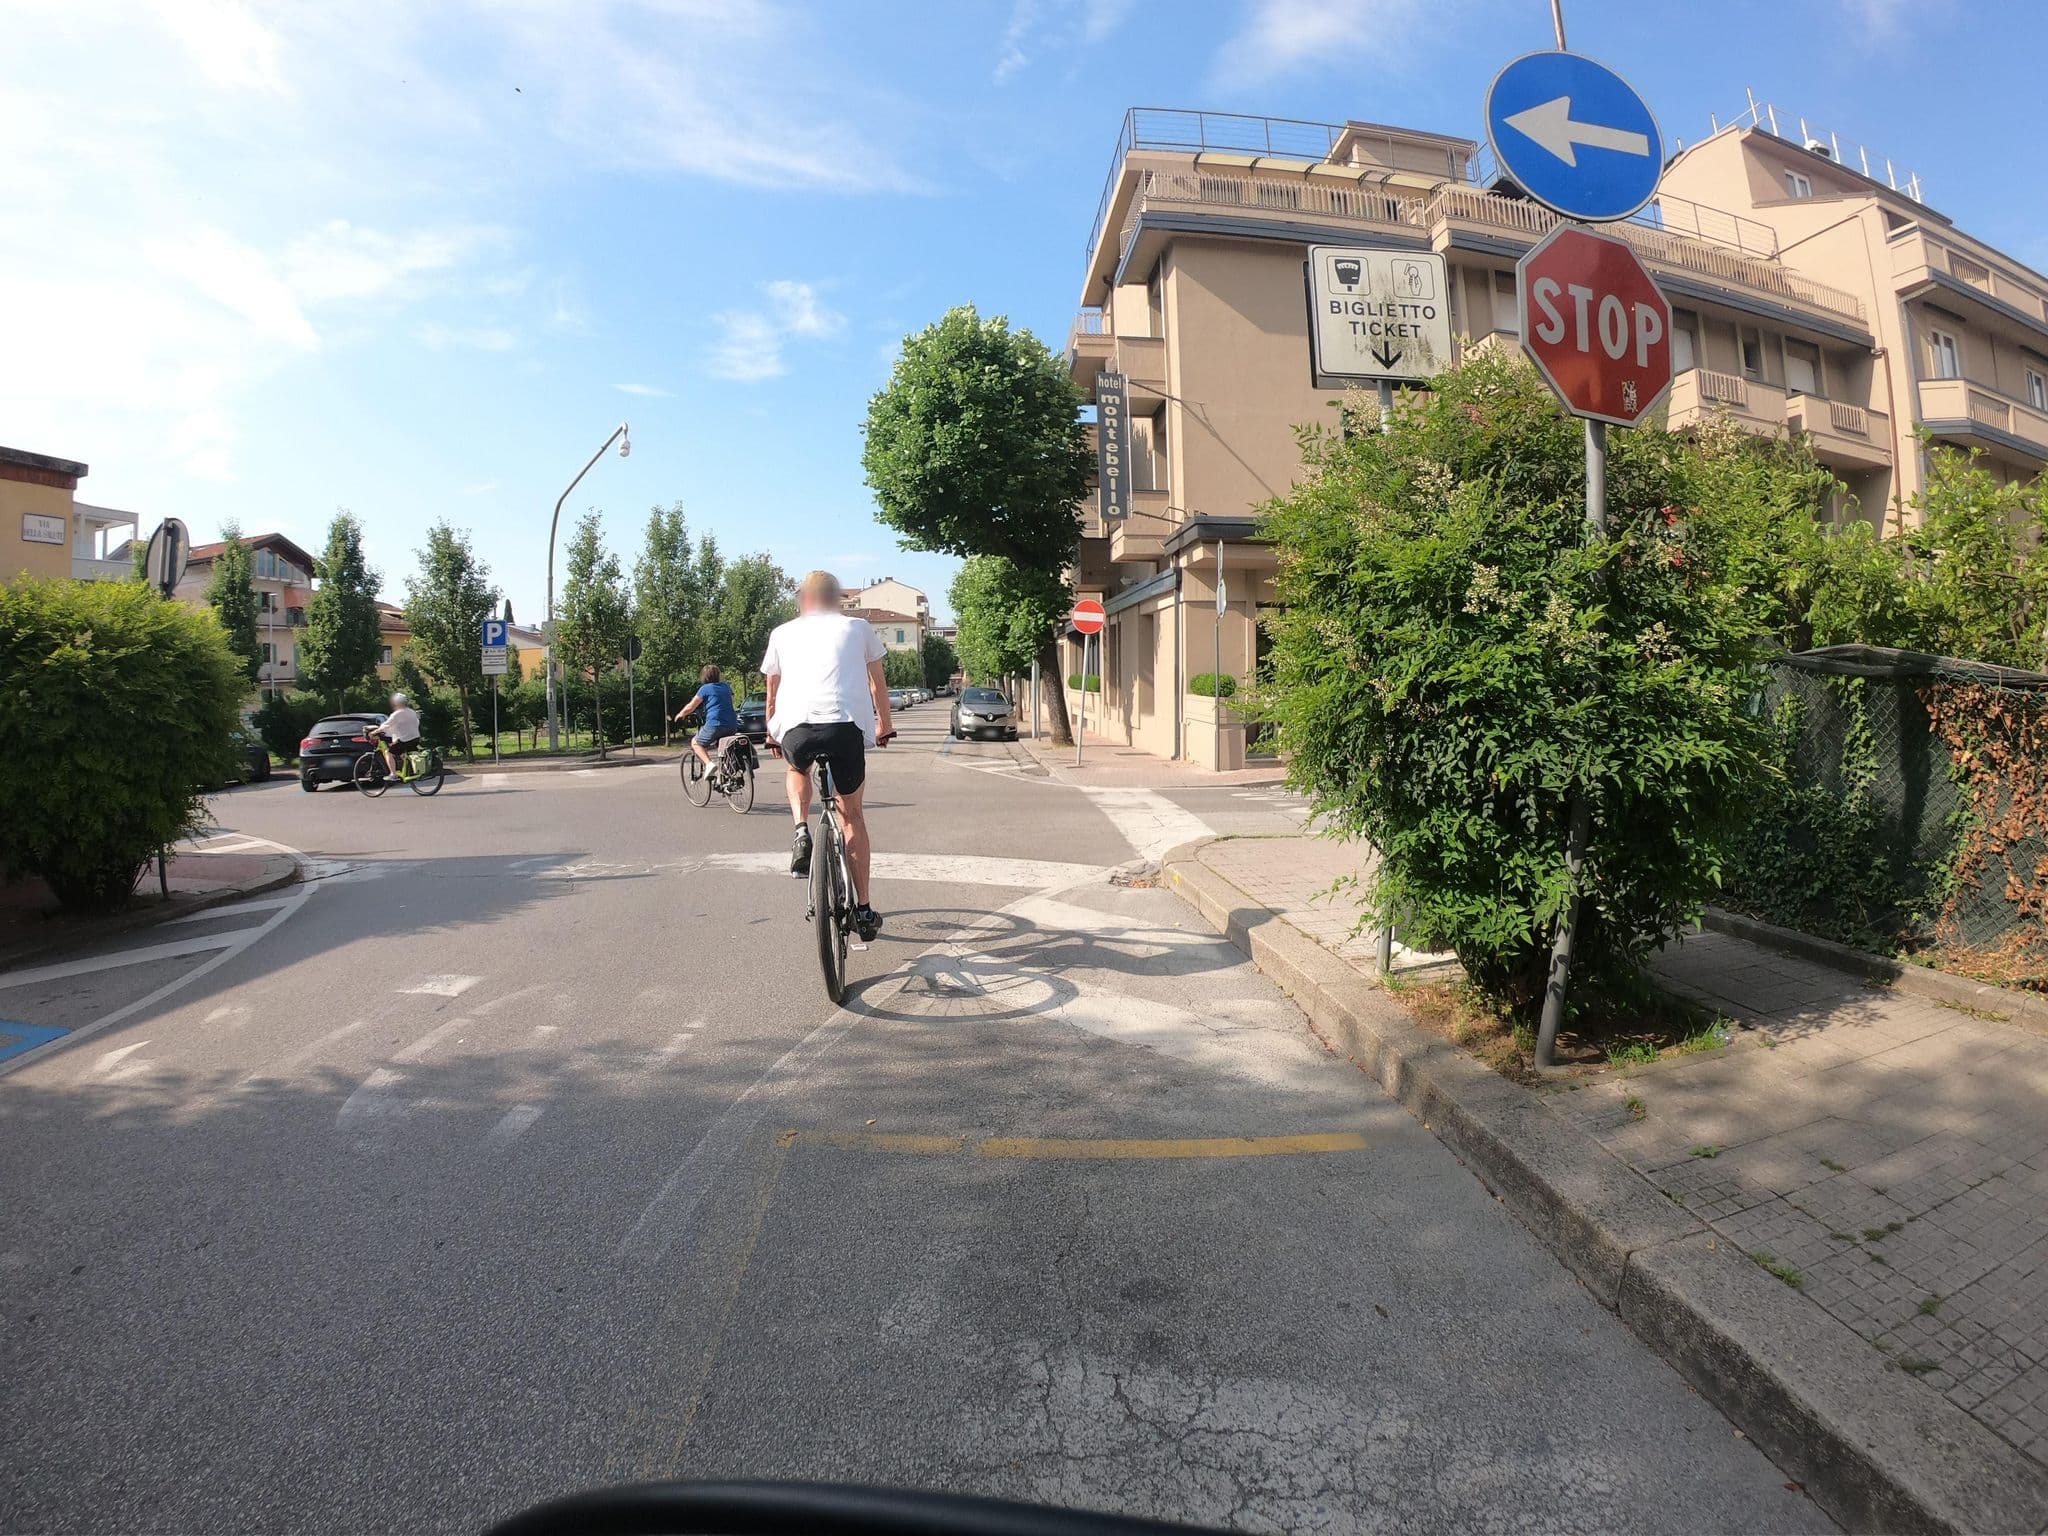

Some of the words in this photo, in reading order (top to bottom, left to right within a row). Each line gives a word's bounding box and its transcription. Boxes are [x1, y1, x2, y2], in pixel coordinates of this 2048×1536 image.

[1330, 300, 1436, 320] BIGLIETTO
[1348, 321, 1421, 338] TICKET
[1533, 277, 1663, 368] STOP
[1098, 375, 1121, 389] hotel
[1101, 394, 1121, 515] montebello
[486, 622, 503, 645] P
